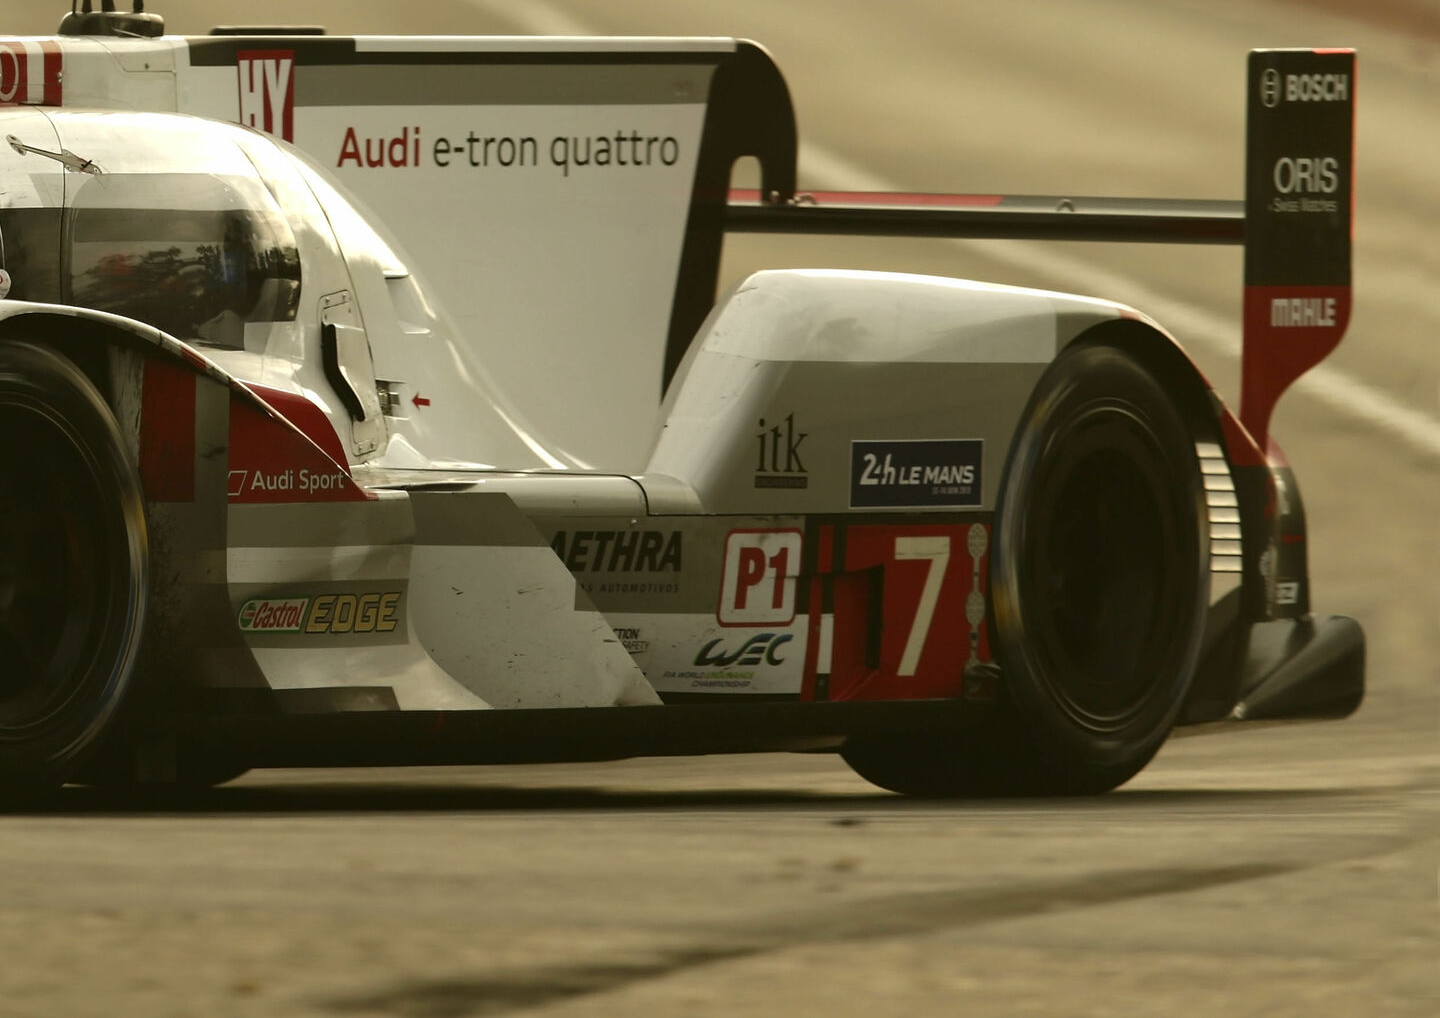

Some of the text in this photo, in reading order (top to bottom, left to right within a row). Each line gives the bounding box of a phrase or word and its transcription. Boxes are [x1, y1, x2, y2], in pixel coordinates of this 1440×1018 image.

[1285, 74, 1348, 101] BOSCH
[336, 126, 679, 177] Audi e-tron quattro
[1274, 157, 1338, 193] ORIS
[1271, 298, 1336, 327] MAHLE
[755, 412, 808, 472] itk
[250, 469, 344, 494] Audi Sport
[859, 453, 974, 485] 24h LE MANS
[734, 547, 789, 610] P1
[252, 592, 402, 634] Castrol EDGE
[693, 633, 794, 666] WEC
